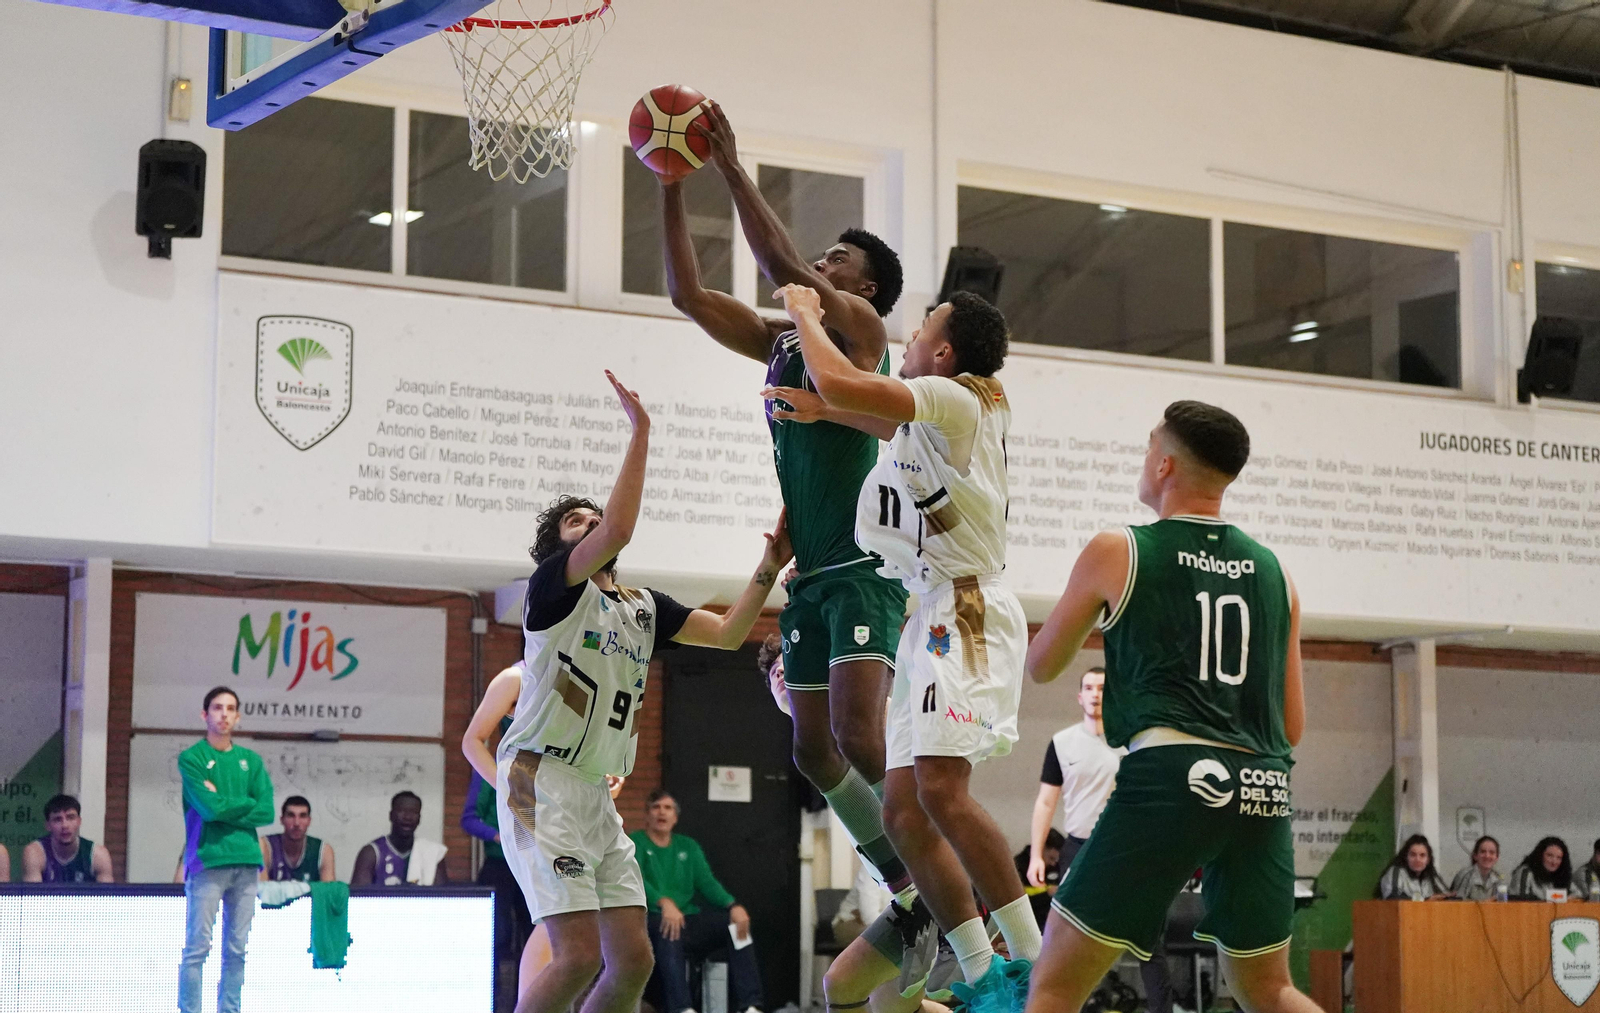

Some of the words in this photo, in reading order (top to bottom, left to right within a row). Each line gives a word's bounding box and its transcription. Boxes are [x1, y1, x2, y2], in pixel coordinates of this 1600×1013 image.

[276, 400, 331, 412] Baloncesto
[277, 381, 330, 399] Unicaja
[395, 378, 445, 397] Joaquín
[450, 381, 553, 406] Entrambasaguas
[564, 393, 600, 409] Julián
[603, 395, 664, 416] Rouez
[675, 402, 717, 420] Manolo
[720, 405, 753, 423] Rubia
[377, 421, 425, 439] Antonio
[430, 425, 477, 443] Benítez
[489, 431, 518, 447] José
[522, 433, 571, 450] Torrubia
[582, 437, 621, 454] Rafael
[675, 446, 702, 461] José
[725, 450, 747, 464] Mur
[386, 398, 418, 416] Paco
[422, 402, 469, 421] Cabello
[480, 407, 520, 425] Miguel
[524, 411, 559, 428] Pérez
[569, 414, 613, 433] Alfonso
[666, 423, 704, 440] Patrick
[708, 426, 768, 445] Fernández
[367, 442, 404, 459] David
[409, 445, 426, 460] Gil
[438, 448, 485, 466] Manolo
[489, 452, 525, 469] Pérez
[537, 455, 577, 472] Rubén
[581, 460, 613, 477] Mayo
[683, 469, 709, 483] Alba
[720, 470, 765, 487] Germán
[1420, 431, 1512, 456] JUGADORES
[1517, 440, 1536, 458] DE
[349, 485, 385, 502] Pablo
[389, 487, 443, 507] Sánchez
[455, 493, 501, 513] Morgan
[643, 506, 680, 523] Rubén
[683, 509, 735, 527] Guerrero
[744, 513, 777, 530] Ismae
[358, 464, 384, 480] Miki
[389, 466, 440, 484] Servera
[454, 471, 484, 487] Rafa
[488, 473, 525, 490] Freire
[537, 477, 588, 497] Augusto
[592, 481, 613, 495] Lim
[643, 488, 668, 501] ablo
[672, 488, 722, 505] Almazán
[734, 492, 772, 508] Carlos
[878, 484, 901, 529] 11
[232, 608, 359, 692] Mijas
[1195, 591, 1251, 686] 10
[240, 702, 362, 719] UNTAMIENTO
[608, 690, 632, 731] 9
[922, 682, 937, 713] 11
[1240, 768, 1288, 789] COSTA
[1241, 786, 1270, 802] DEL
